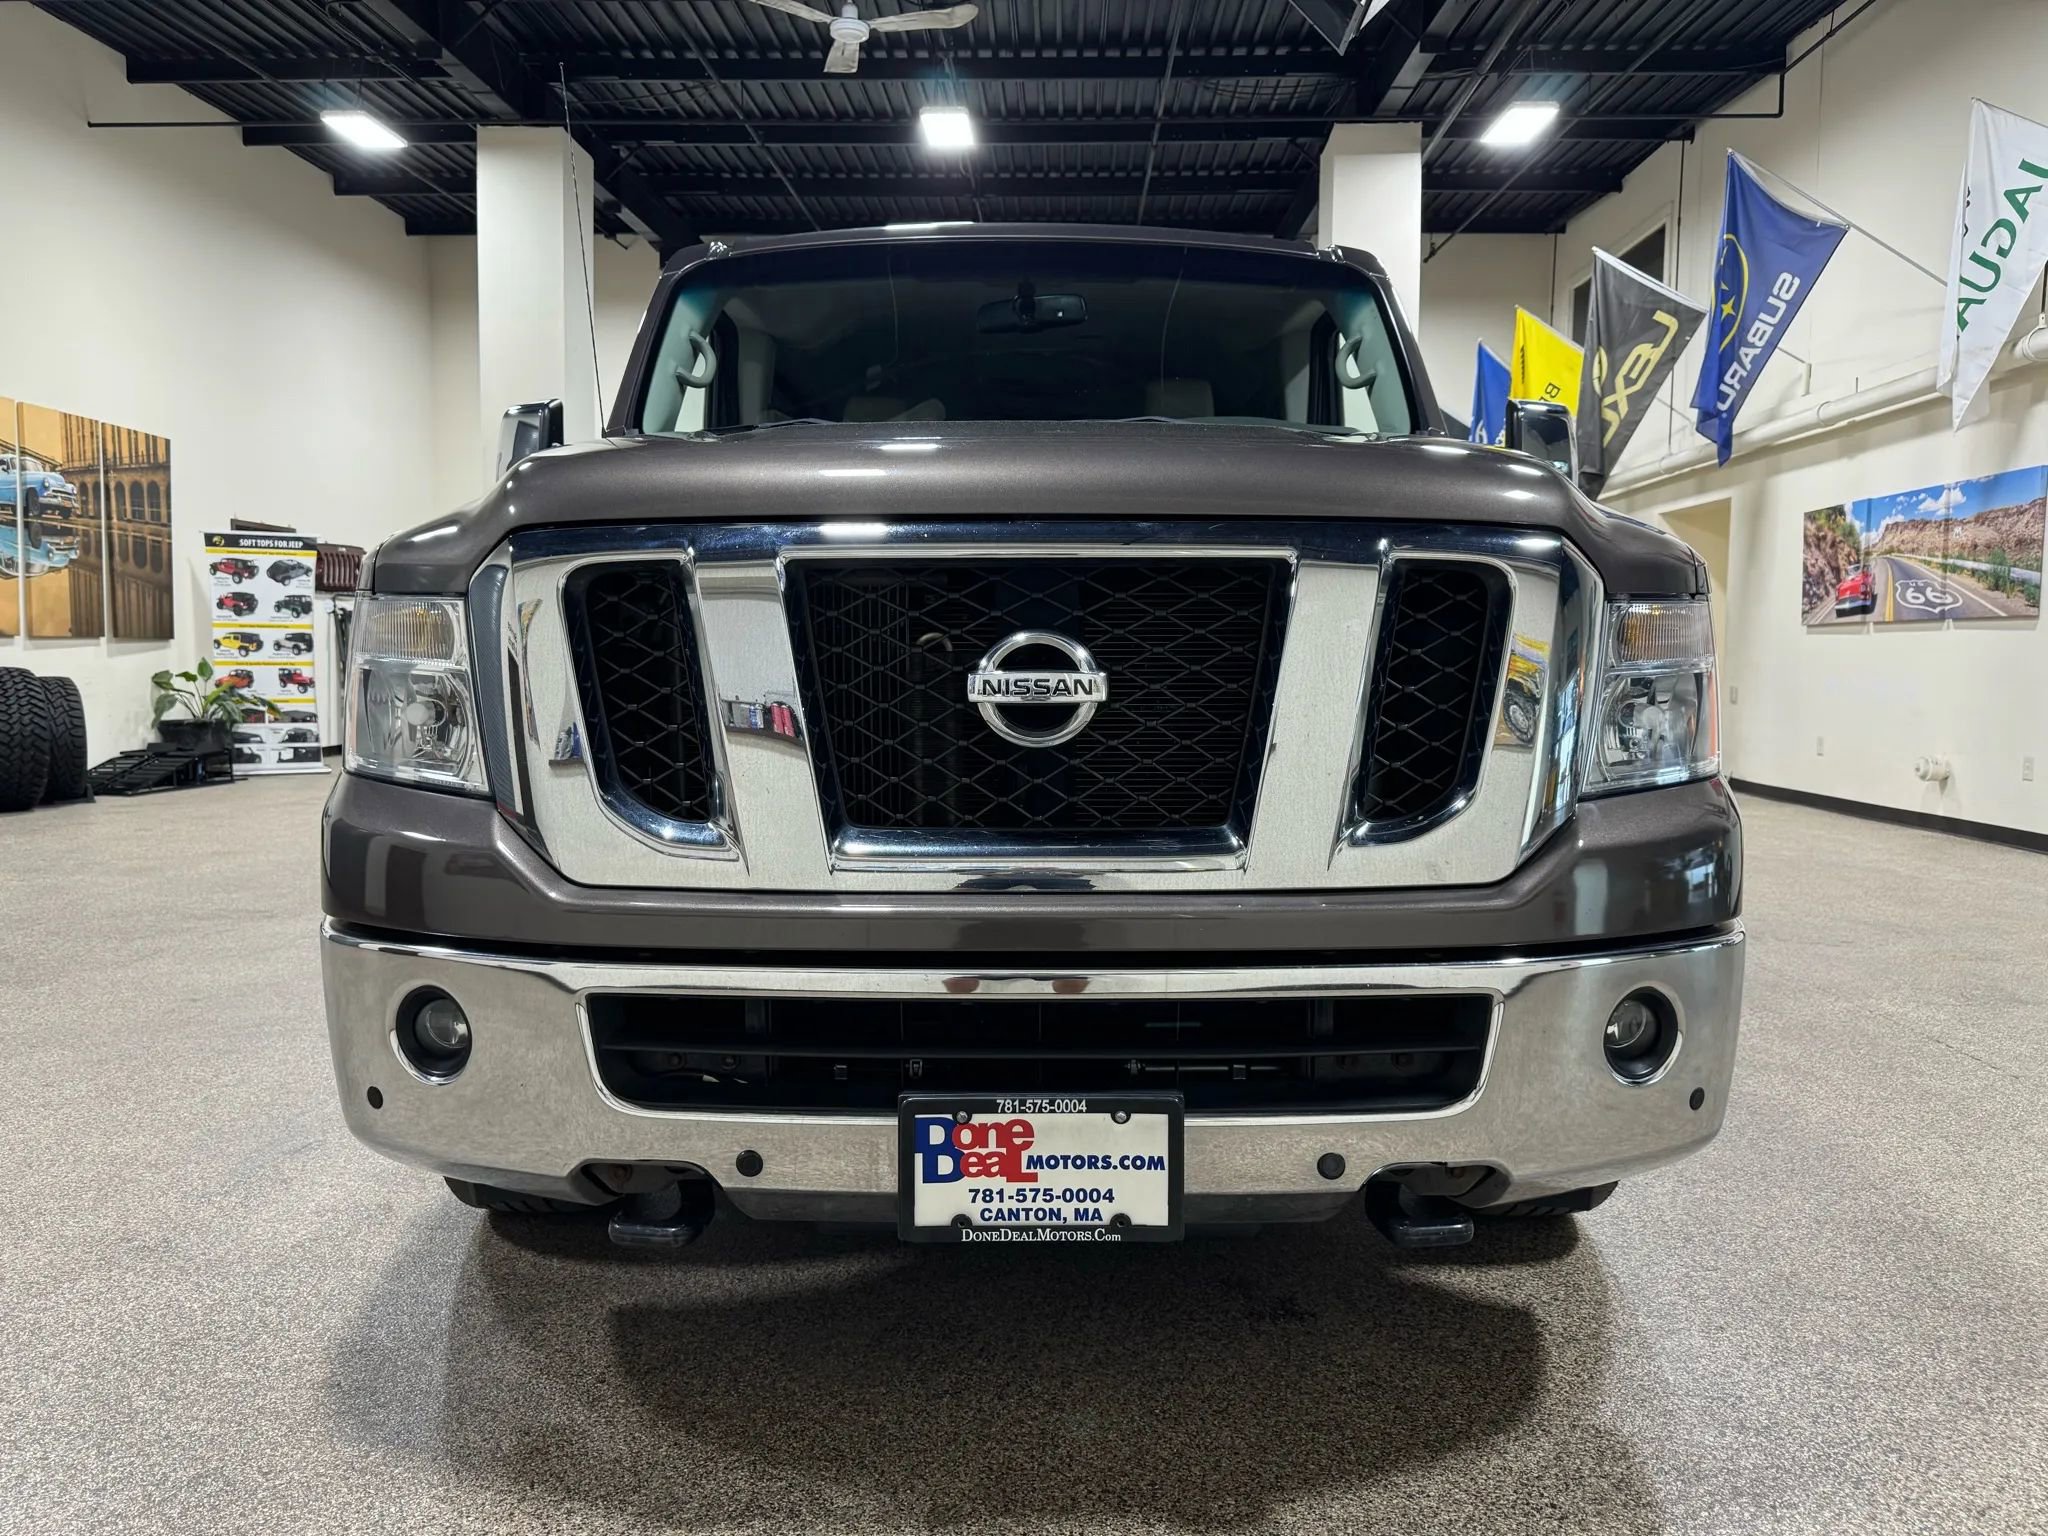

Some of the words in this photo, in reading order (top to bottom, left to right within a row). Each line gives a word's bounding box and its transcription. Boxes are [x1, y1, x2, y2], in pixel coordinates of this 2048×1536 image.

[240, 538, 256, 547] SOFT
[257, 539, 273, 547] TOPS
[275, 539, 287, 548] FOR
[288, 540, 304, 549] JEEP
[1906, 587, 1953, 604] 66
[981, 678, 1094, 697] NISSAN
[996, 1099, 1087, 1113] 781-575-0004
[914, 1117, 1035, 1153] Done
[1025, 1154, 1166, 1171] MOTORS.COM
[968, 1188, 1115, 1204] 781-575-0004
[980, 1207, 1067, 1224] CANTON,
[1074, 1207, 1103, 1222] MA
